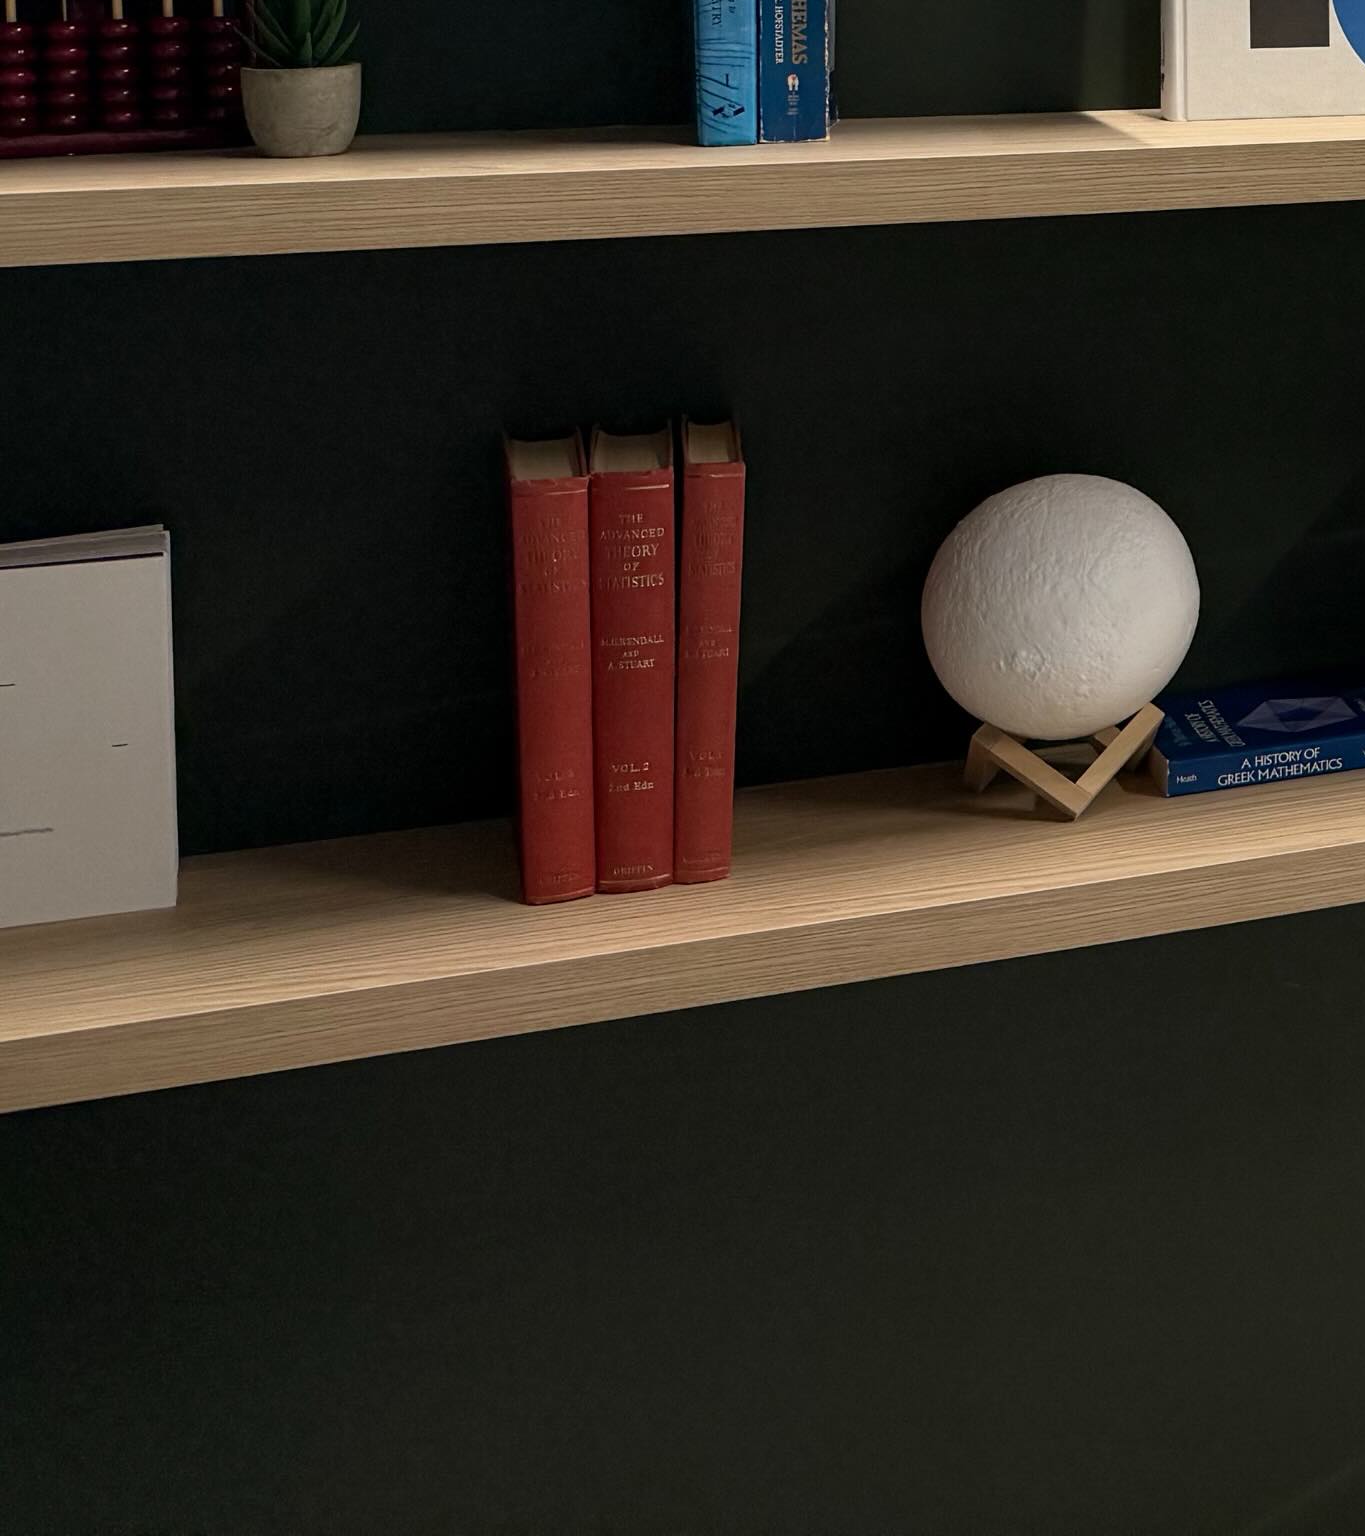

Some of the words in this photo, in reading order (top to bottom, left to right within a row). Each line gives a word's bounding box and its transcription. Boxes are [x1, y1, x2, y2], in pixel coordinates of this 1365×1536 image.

[775, 6, 783, 64] HOFSTADTER
[619, 513, 643, 523] THE
[600, 527, 665, 539] ADVANCED
[624, 562, 640, 571] OF
[1241, 758, 1250, 769] A
[1255, 750, 1301, 767] HISTORY
[1304, 747, 1321, 759] OF
[1218, 771, 1255, 786] GREEK
[1258, 758, 1343, 781] MATHEMATICS
[1176, 774, 1197, 784] Heath
